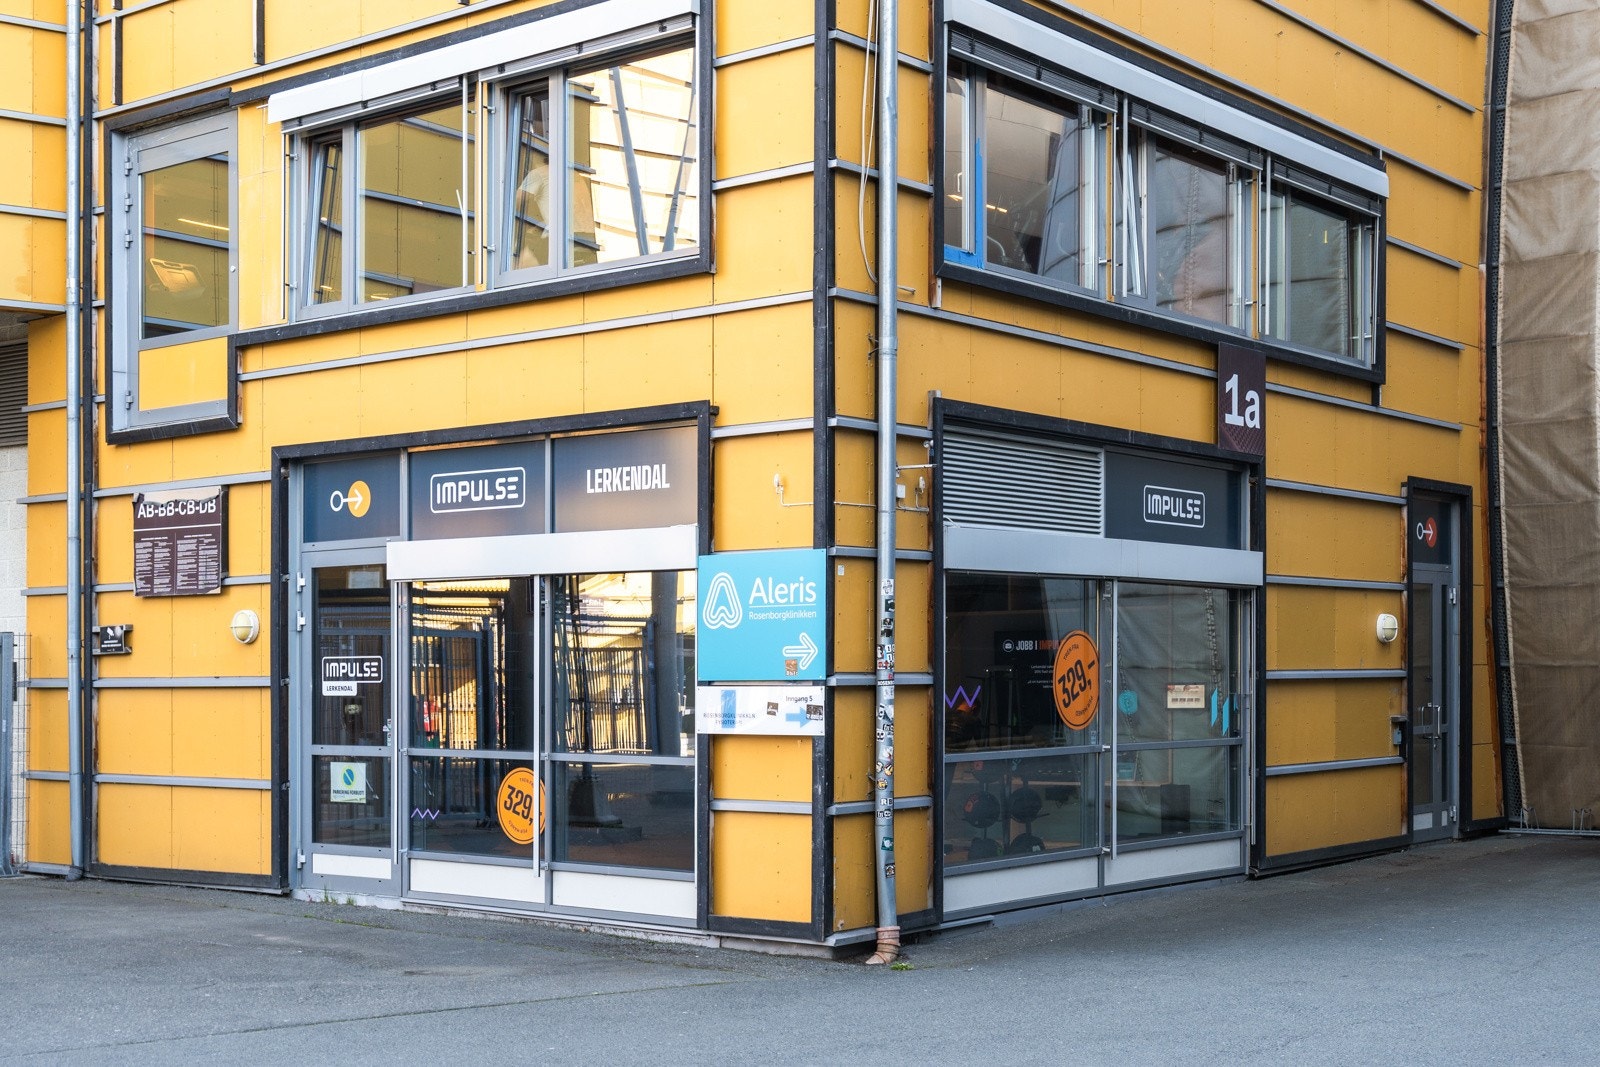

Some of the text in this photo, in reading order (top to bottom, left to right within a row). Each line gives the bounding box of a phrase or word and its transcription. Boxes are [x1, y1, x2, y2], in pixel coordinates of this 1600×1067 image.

[1225, 373, 1261, 430] 1a
[436, 476, 519, 505] IMPULSE
[586, 464, 671, 494] LERKENDAL
[1148, 493, 1202, 520] IMPULSE
[748, 576, 817, 604] Aleris
[749, 610, 817, 620] Rosenborgklinikken
[1016, 640, 1033, 650] JOBB
[326, 662, 379, 677] IMPULSE
[1058, 660, 1095, 708] 329,-
